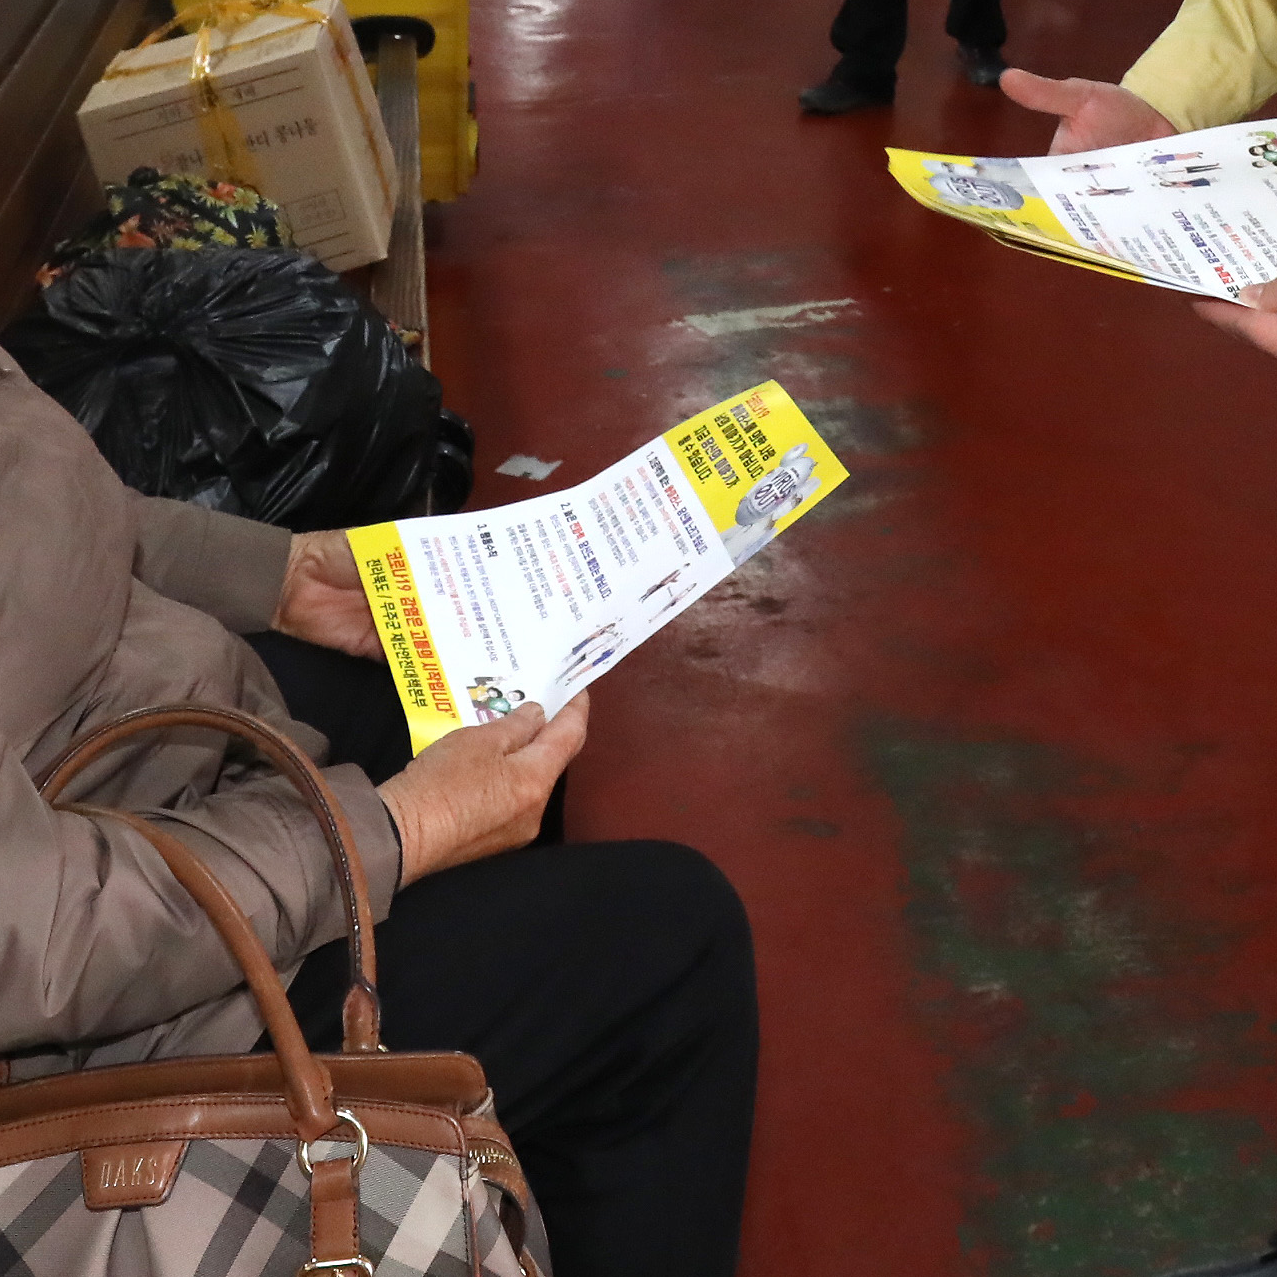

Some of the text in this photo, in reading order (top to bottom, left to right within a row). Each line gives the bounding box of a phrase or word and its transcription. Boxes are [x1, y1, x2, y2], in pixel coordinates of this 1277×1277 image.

[683, 443, 695, 452] 수
[694, 425, 710, 441] 지금
[714, 457, 740, 489] 이야기가
[722, 423, 747, 453] 이야기가
[739, 449, 768, 481] 아닙니다.
[686, 449, 712, 484] 있습니다.
[754, 483, 782, 511] OUT
[771, 470, 798, 501] VIRUS
[564, 510, 577, 522] 높은
[579, 541, 595, 560] 당신도
[595, 574, 611, 601] 아닙니다.
[400, 597, 423, 627] 감염은
[366, 559, 389, 592] 전라북도
[380, 603, 401, 630] 무주군
[391, 633, 428, 707] 재난안전대책본부
[410, 630, 434, 658] 고통의
[100, 1158, 159, 1190] DAKS
